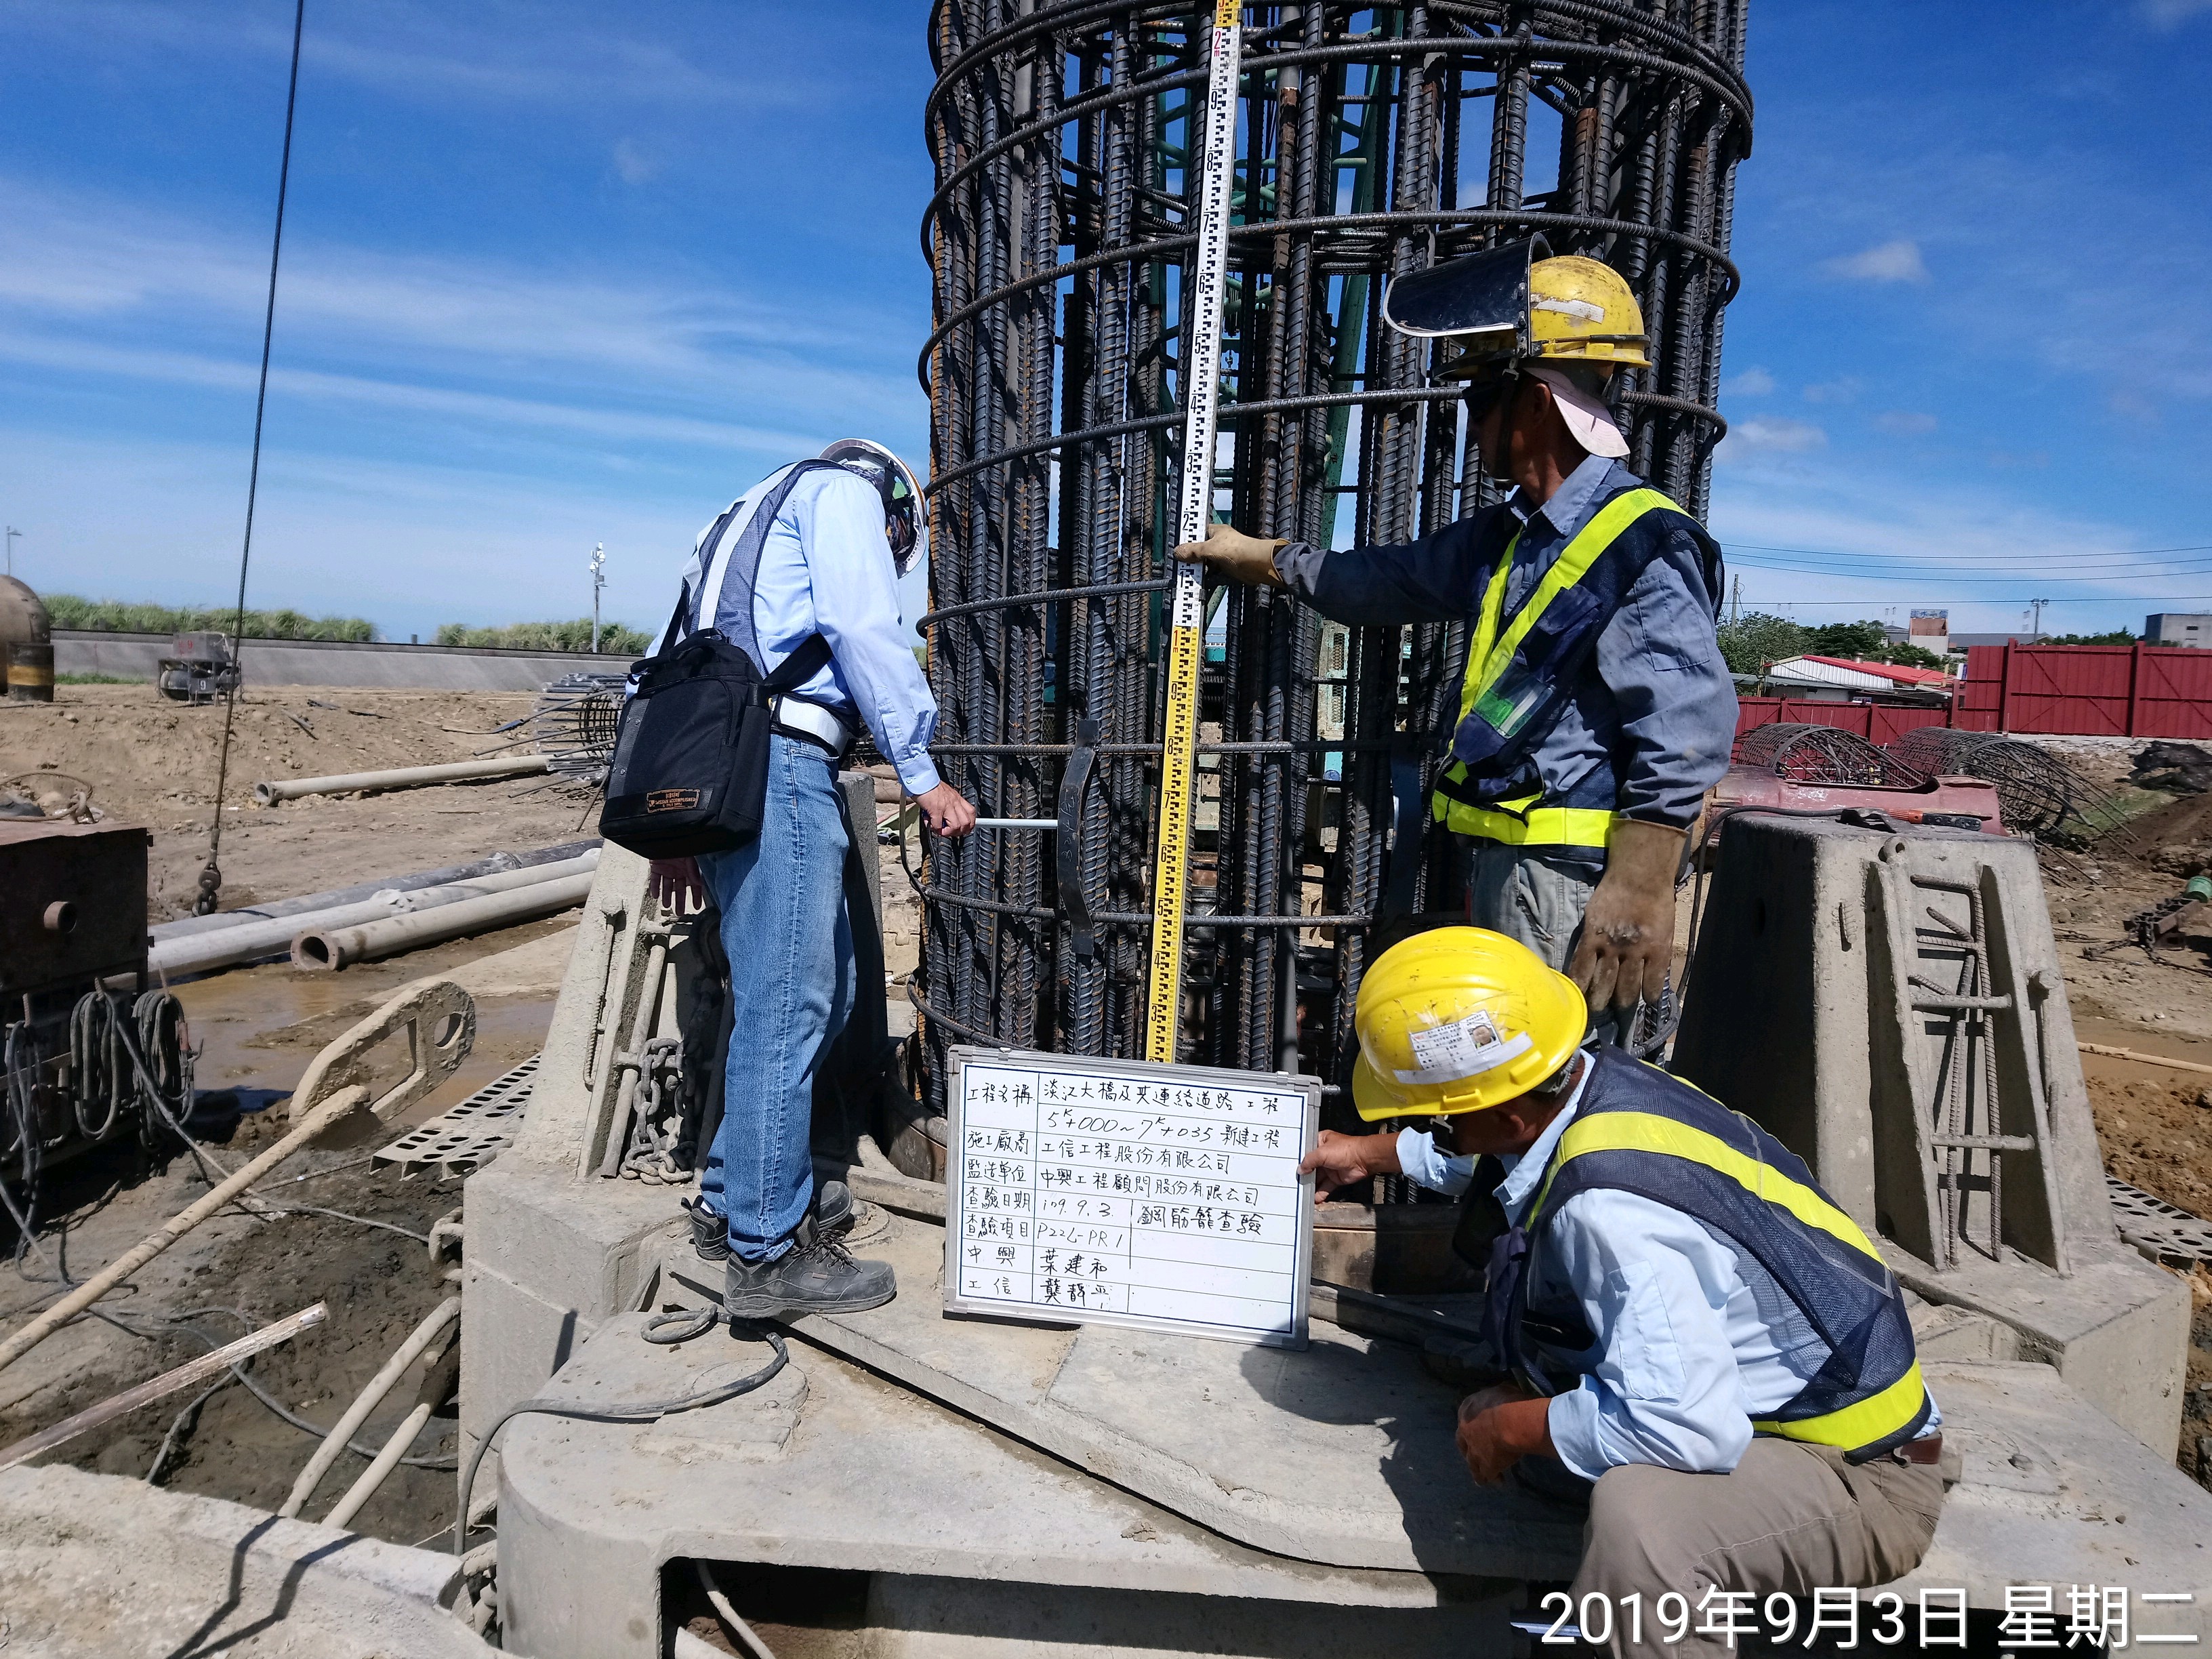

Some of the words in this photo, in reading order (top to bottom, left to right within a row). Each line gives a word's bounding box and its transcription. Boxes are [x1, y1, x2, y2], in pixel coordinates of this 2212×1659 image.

[1214, 30, 1221, 49] 2
[1210, 91, 1217, 110] 9
[1207, 152, 1213, 171] 8
[1204, 214, 1209, 232] 7
[1199, 274, 1205, 293] 6
[1195, 335, 1202, 354] 5
[1190, 396, 1197, 413] 4
[1187, 455, 1193, 473] 3
[1183, 514, 1189, 531] 2
[1180, 571, 1184, 588] 1
[1174, 630, 1178, 646] 1
[200, 680, 207, 691] 9
[1171, 683, 1177, 699] 9
[1168, 738, 1174, 755] 8
[1164, 792, 1170, 808] 7
[1161, 846, 1167, 863] 6
[1158, 899, 1164, 916] 5
[1154, 952, 1161, 968] 4
[1151, 1005, 1157, 1021] 3
[1041, 1139, 1230, 1174] 工信工程股份有限公司
[1040, 1168, 1258, 1206] 中興工程顧問股份有限公司
[966, 1186, 1031, 1212] 查驗日期
[965, 1214, 1028, 1240] 查驗項目
[1137, 1206, 1264, 1235] 鋼筋籠查驗
